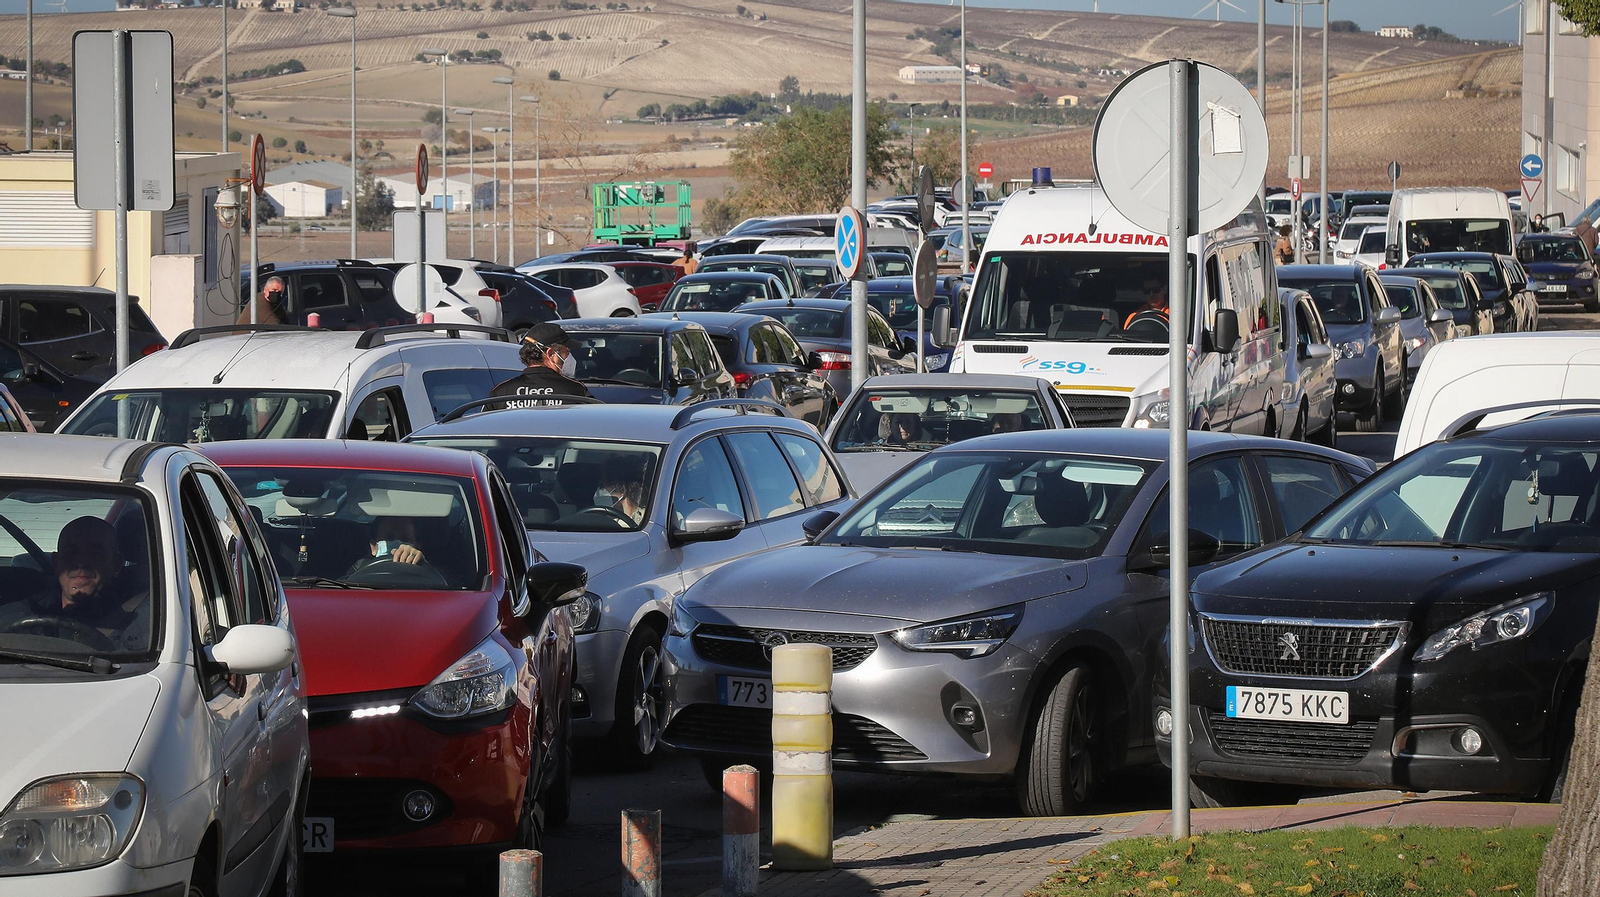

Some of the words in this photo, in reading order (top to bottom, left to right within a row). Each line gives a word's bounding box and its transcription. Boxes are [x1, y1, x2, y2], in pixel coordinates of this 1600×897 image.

[516, 386, 554, 395] Clece
[506, 399, 563, 410] SEGURAD
[732, 681, 773, 704] 773
[1241, 691, 1293, 716] 7875
[1301, 694, 1342, 719] KKC
